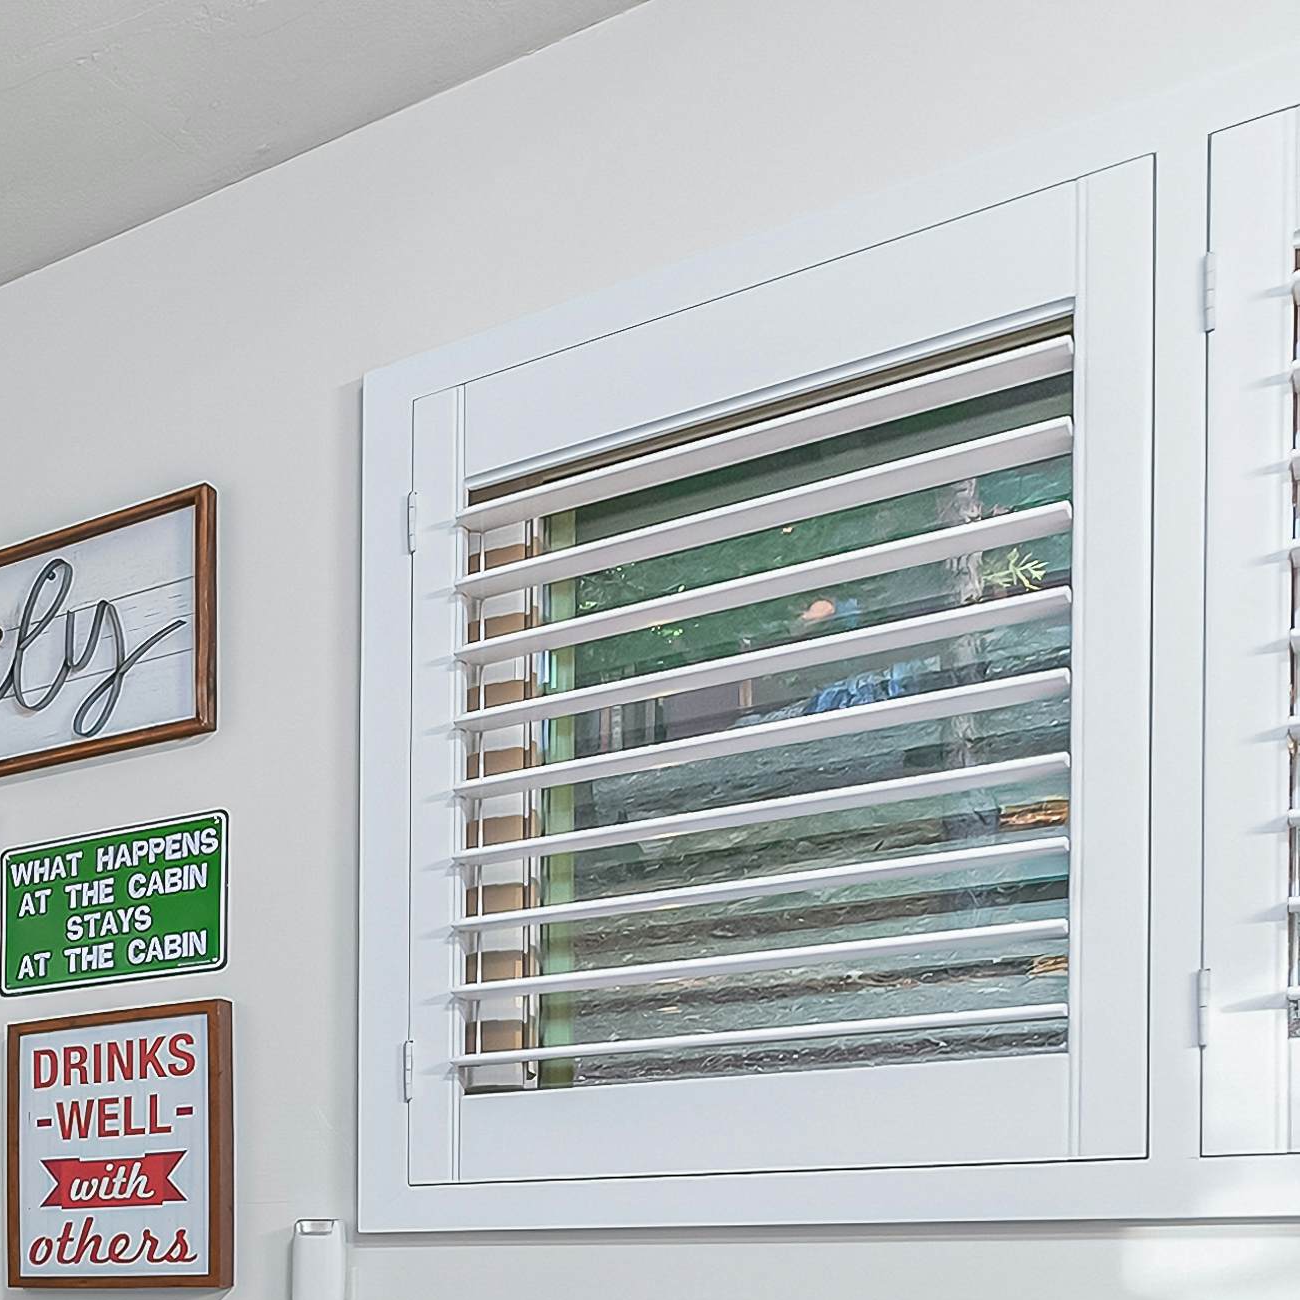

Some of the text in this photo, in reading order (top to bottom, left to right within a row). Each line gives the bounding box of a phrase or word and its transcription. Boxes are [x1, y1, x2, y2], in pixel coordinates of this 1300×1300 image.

[11, 828, 219, 887] WHAT HAPPENS
[18, 863, 208, 917] AT THE CABIN
[66, 905, 152, 941] STAYS
[17, 930, 207, 980] AT THE CABIN
[32, 1033, 196, 1089] DRINKS
[70, 1161, 155, 1201] with
[28, 1217, 198, 1266] others
